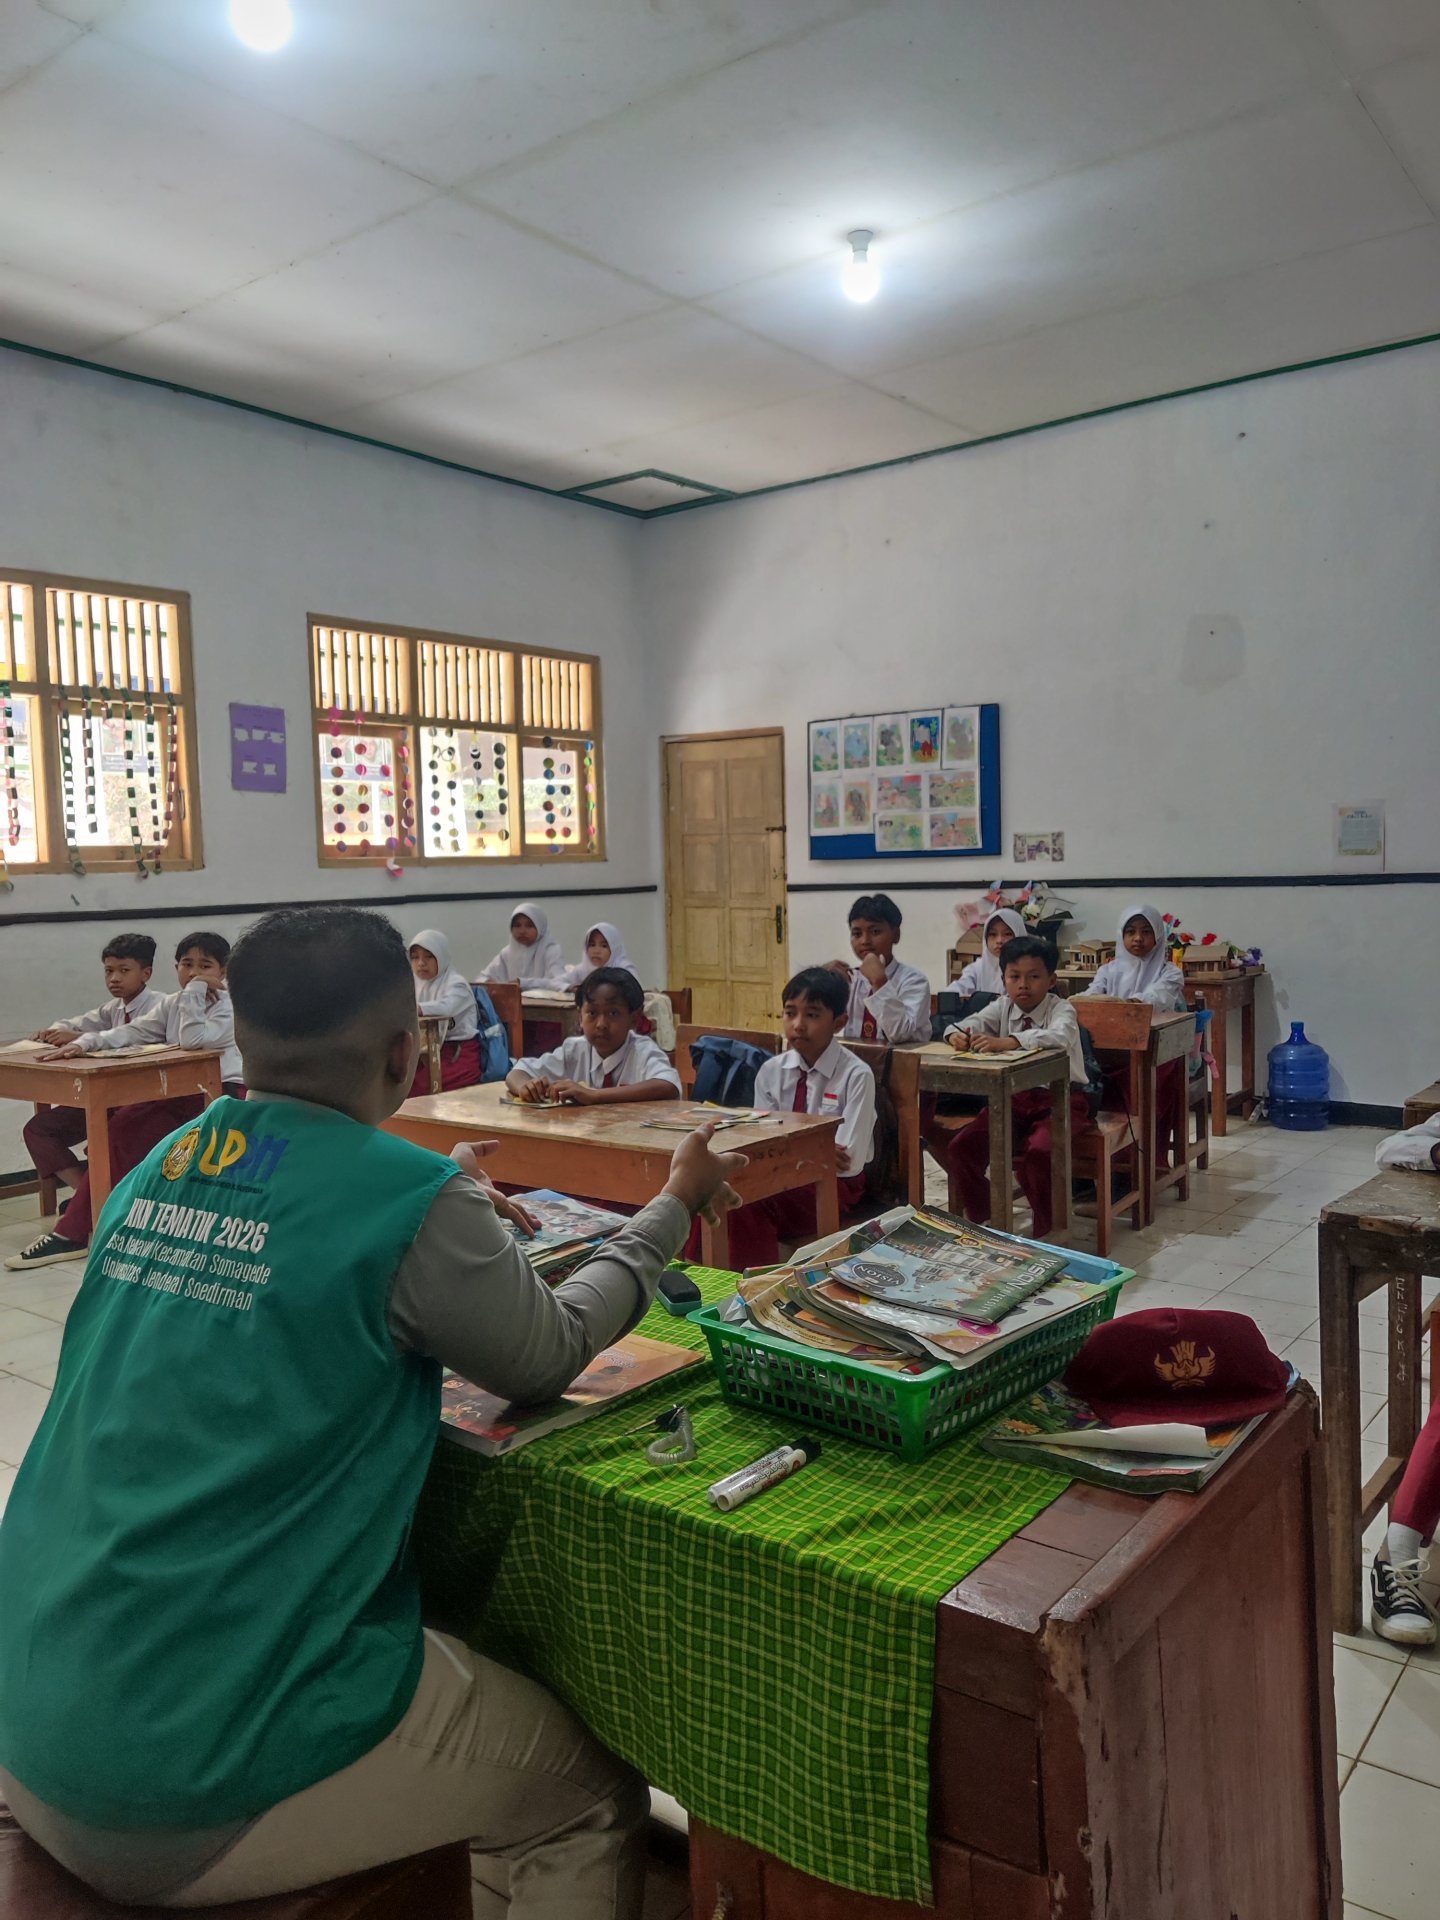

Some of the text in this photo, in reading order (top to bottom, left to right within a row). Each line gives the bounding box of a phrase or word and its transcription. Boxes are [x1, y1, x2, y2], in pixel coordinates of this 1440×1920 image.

[150, 1202, 219, 1244] TEMATIK
[212, 1216, 270, 1254] 2026
[209, 1254, 271, 1285] Somagede
[856, 1265, 900, 1285] VISION
[1006, 1258, 1058, 1290] VISION
[142, 1267, 185, 1296] Jenderal
[184, 1277, 253, 1311] Soedirman
